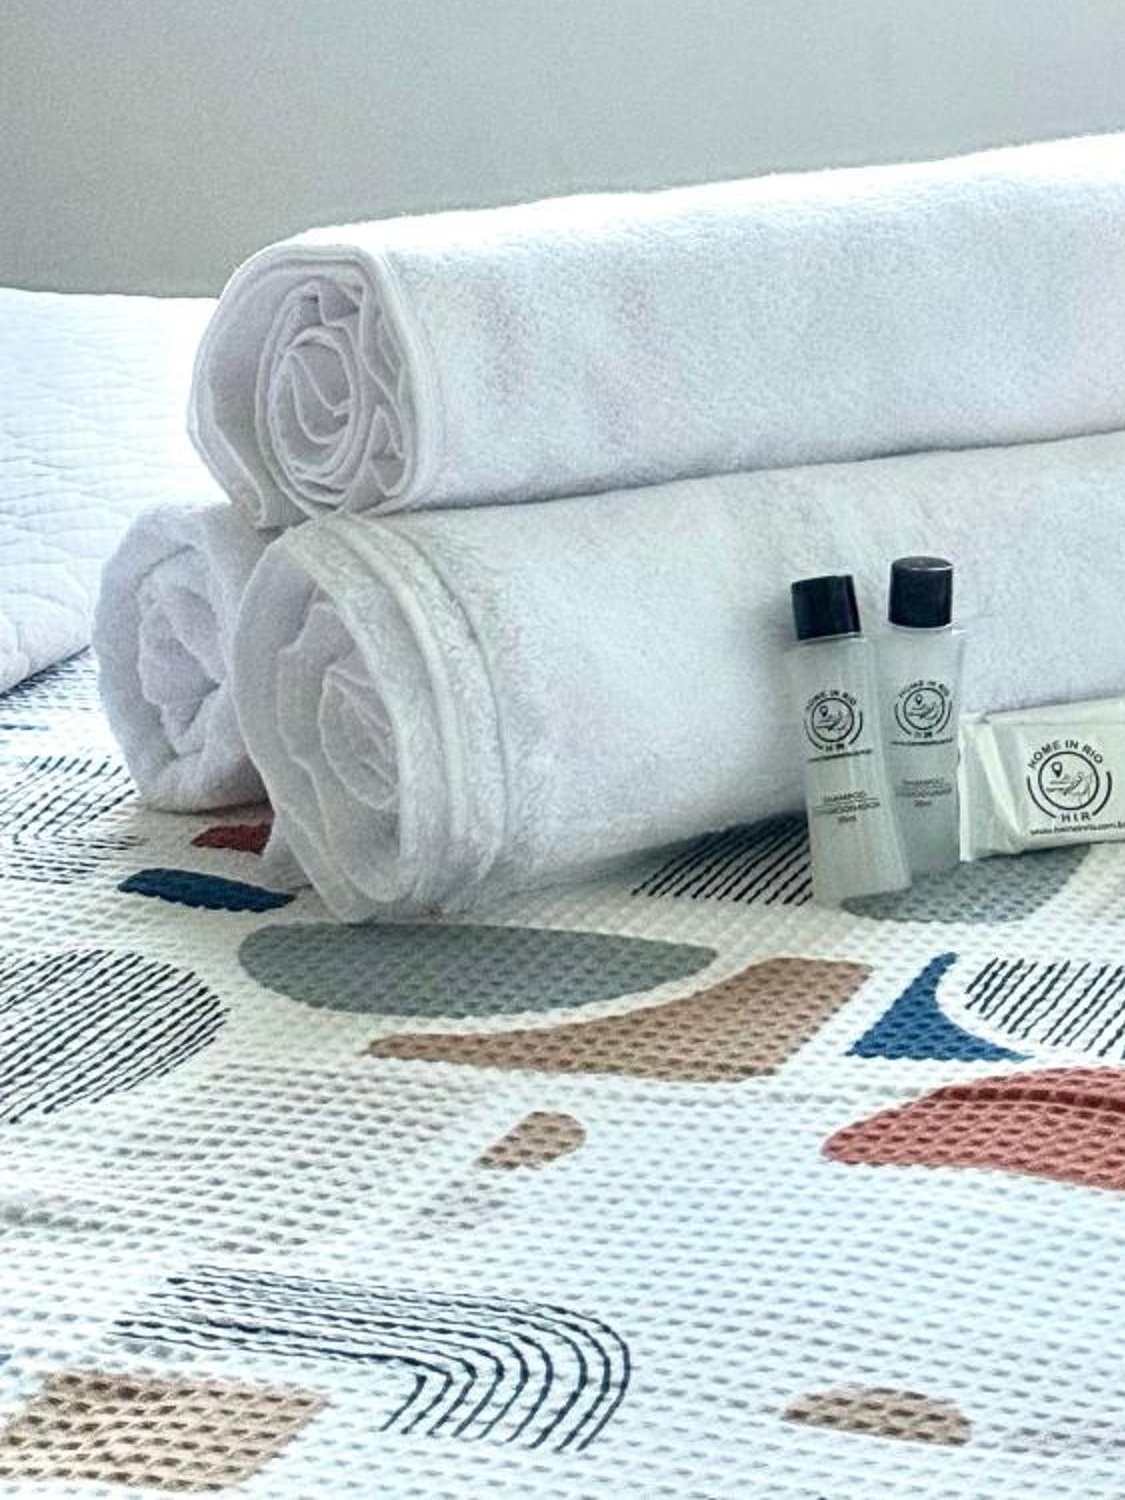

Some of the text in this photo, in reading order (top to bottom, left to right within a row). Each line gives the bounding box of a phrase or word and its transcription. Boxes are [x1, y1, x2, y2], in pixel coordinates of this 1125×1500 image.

[1028, 739, 1104, 769] HOME IN RIO
